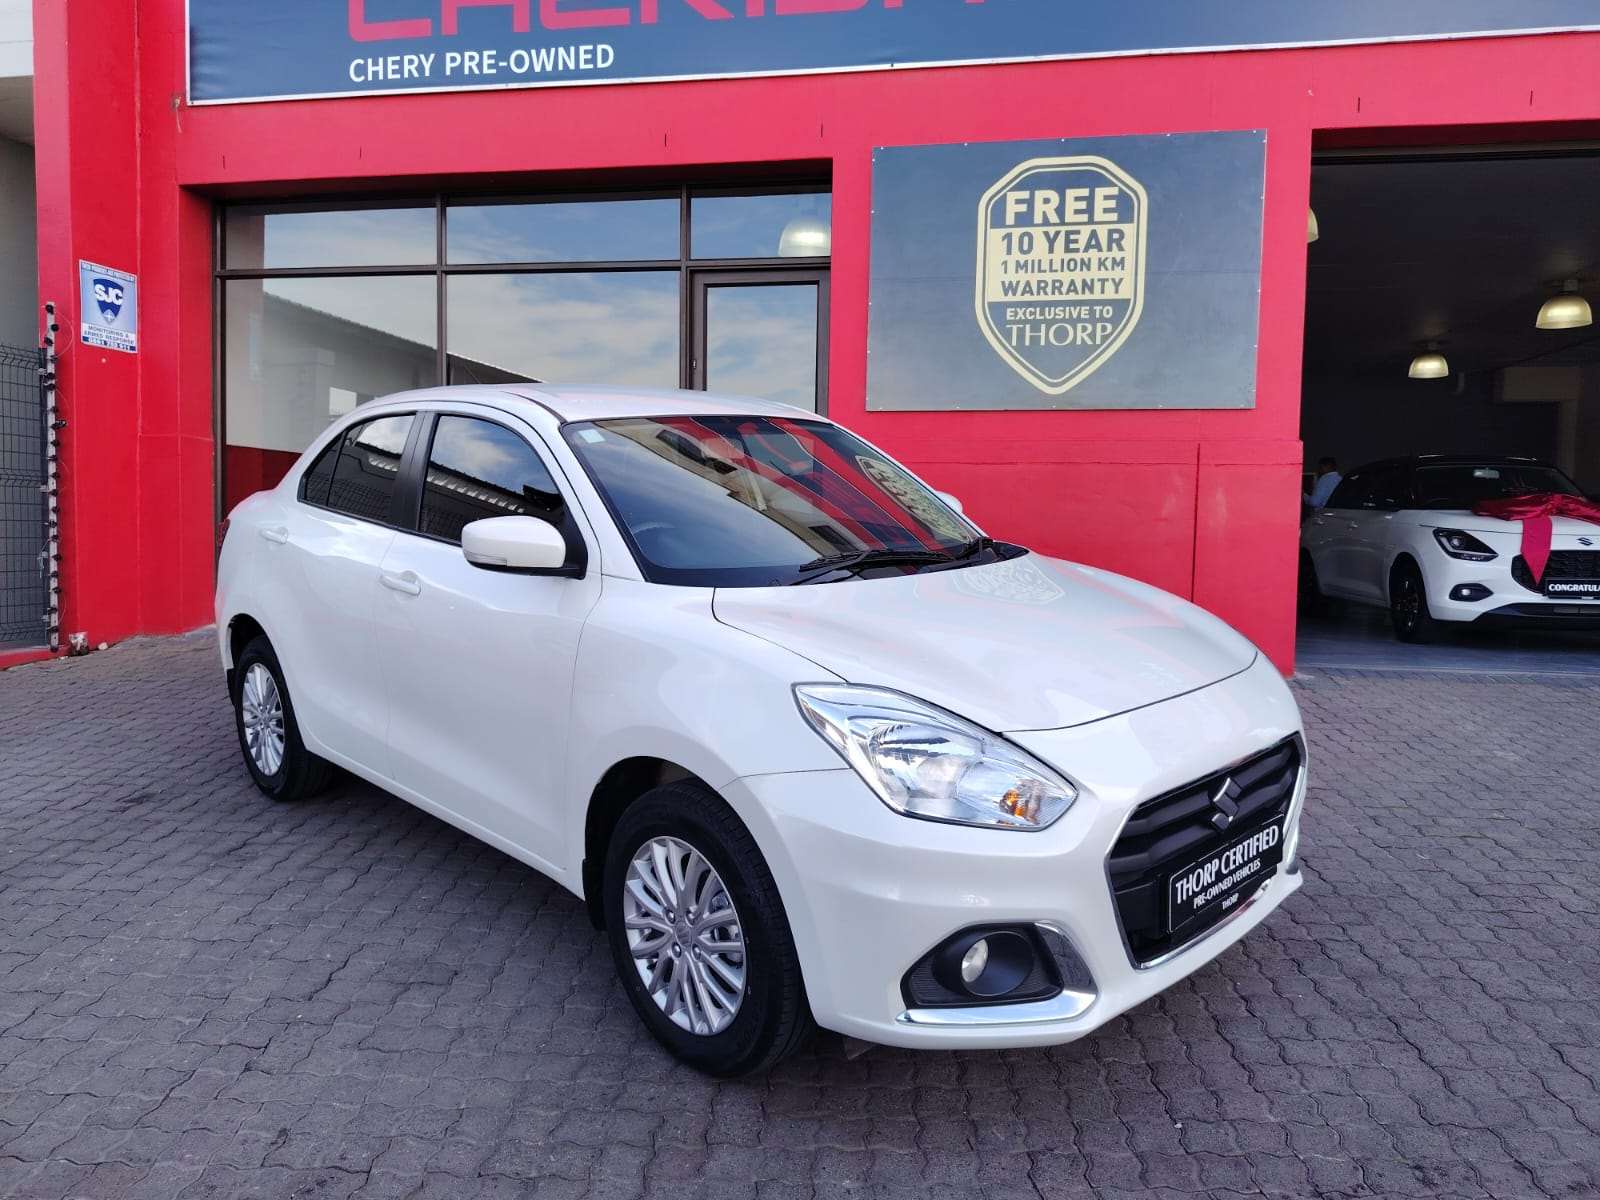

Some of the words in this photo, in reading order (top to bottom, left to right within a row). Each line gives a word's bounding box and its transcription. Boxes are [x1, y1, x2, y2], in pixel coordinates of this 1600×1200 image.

[349, 53, 436, 83] CHERY
[445, 44, 615, 75] PRE-OWNED
[1005, 187, 1120, 225] FREE
[1001, 231, 1034, 256] 10
[1043, 228, 1126, 254] YEAR
[1001, 259, 1008, 274] 1
[1015, 258, 1091, 274] MILLION
[1097, 257, 1125, 272] KM
[94, 284, 123, 306] SJC
[1000, 277, 1124, 297] WARRANTY
[1006, 306, 1090, 321] EXCLUSIVE
[1094, 306, 1113, 319] TO
[1006, 322, 1113, 346] THORP
[1548, 583, 1600, 592] CONGRATUL
[1175, 858, 1220, 904] THORP
[1220, 825, 1279, 875] CERTIFIED
[1193, 875, 1233, 909] PRE-OWNED
[1232, 857, 1261, 883] VEHICLES
[1221, 892, 1239, 910] THORP
